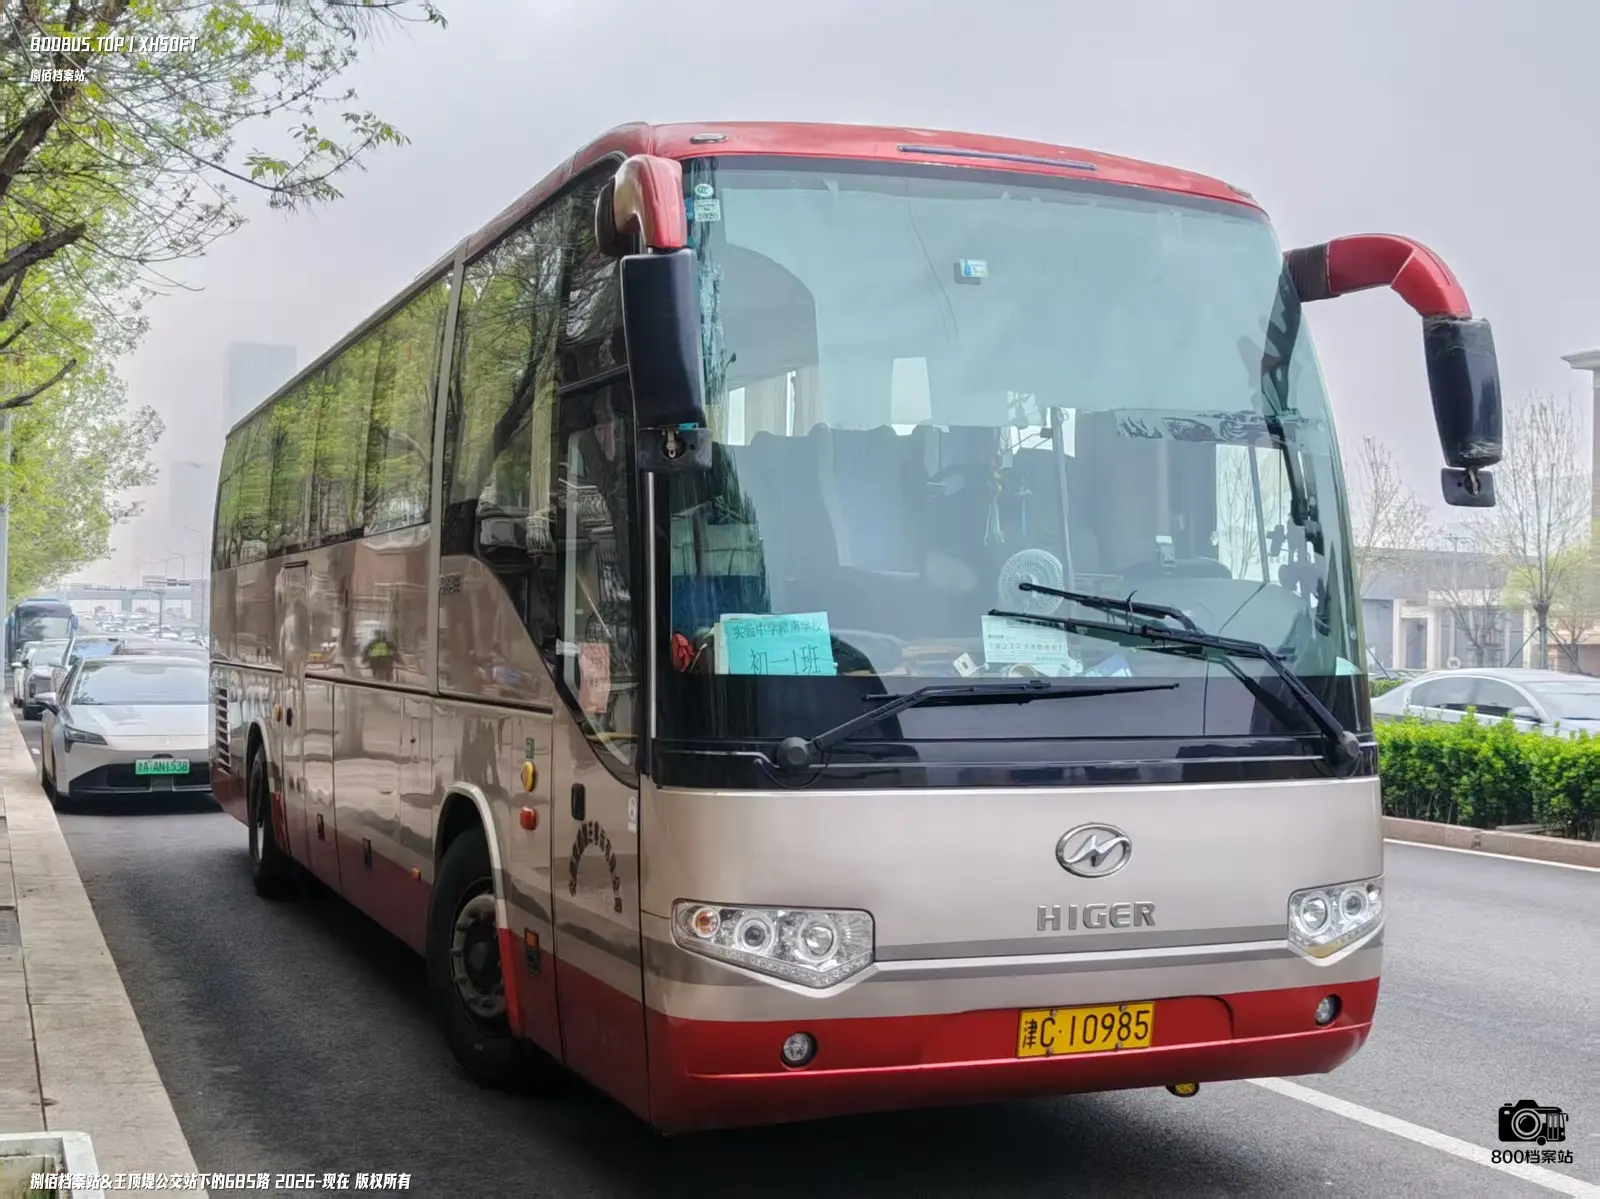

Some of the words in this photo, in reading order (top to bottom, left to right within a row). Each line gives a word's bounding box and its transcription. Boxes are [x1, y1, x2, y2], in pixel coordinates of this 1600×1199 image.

[750, 645, 821, 676] 初一1班
[1037, 901, 1156, 931] HIGER
